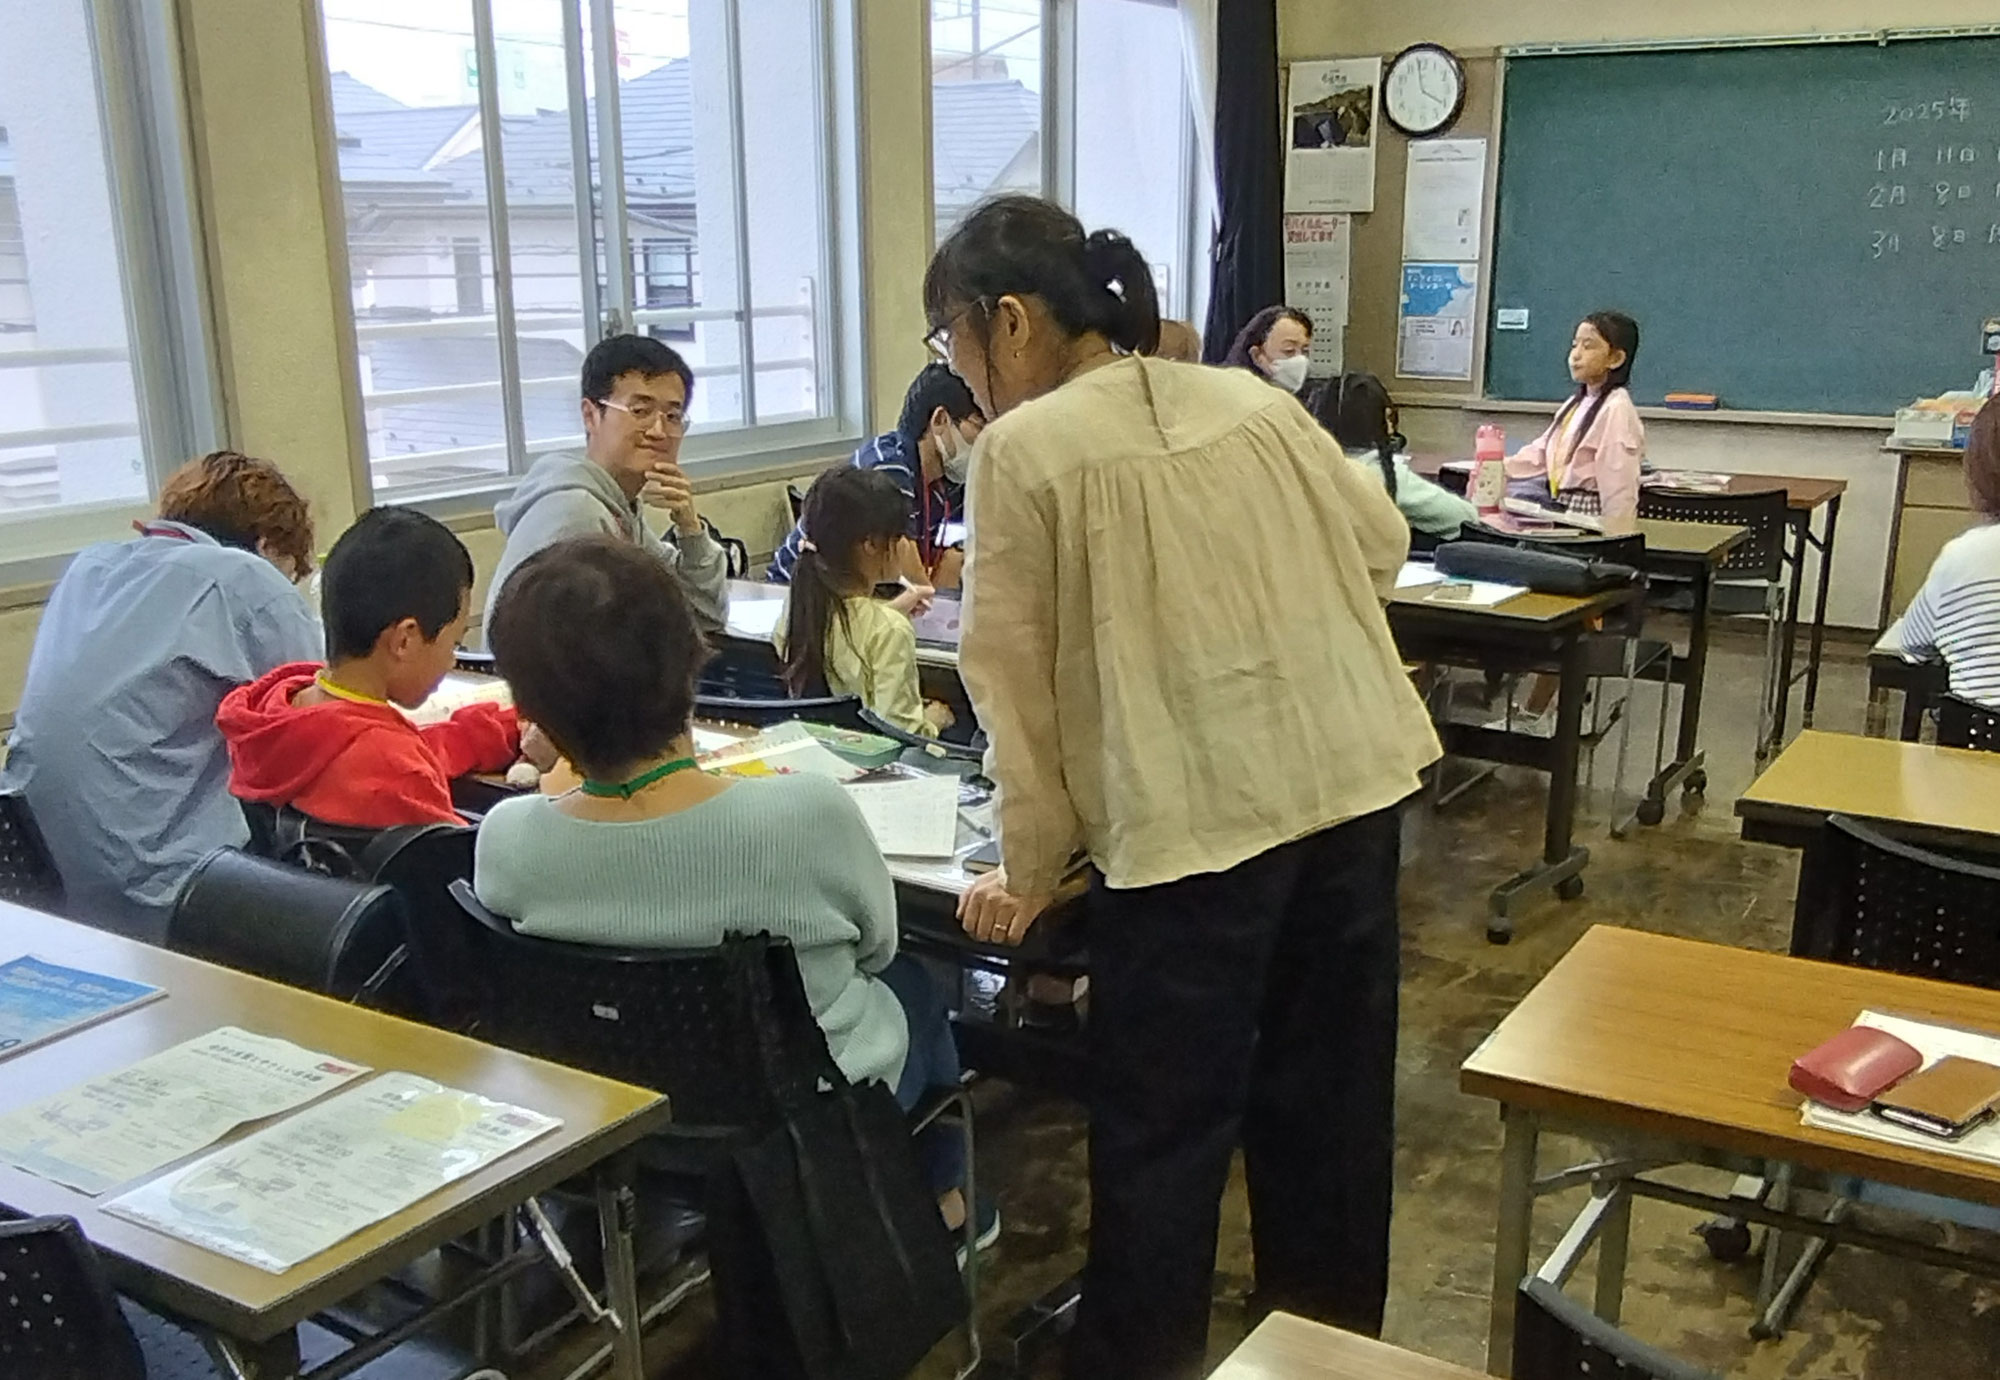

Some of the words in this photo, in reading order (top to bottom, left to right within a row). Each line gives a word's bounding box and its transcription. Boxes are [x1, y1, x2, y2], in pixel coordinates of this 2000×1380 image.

[1882, 96, 1971, 125] 2025年
[1878, 147, 1907, 170] 1月
[1936, 146, 1975, 164] 11日
[1867, 184, 1905, 208] 2月
[1872, 230, 1899, 259] 3月
